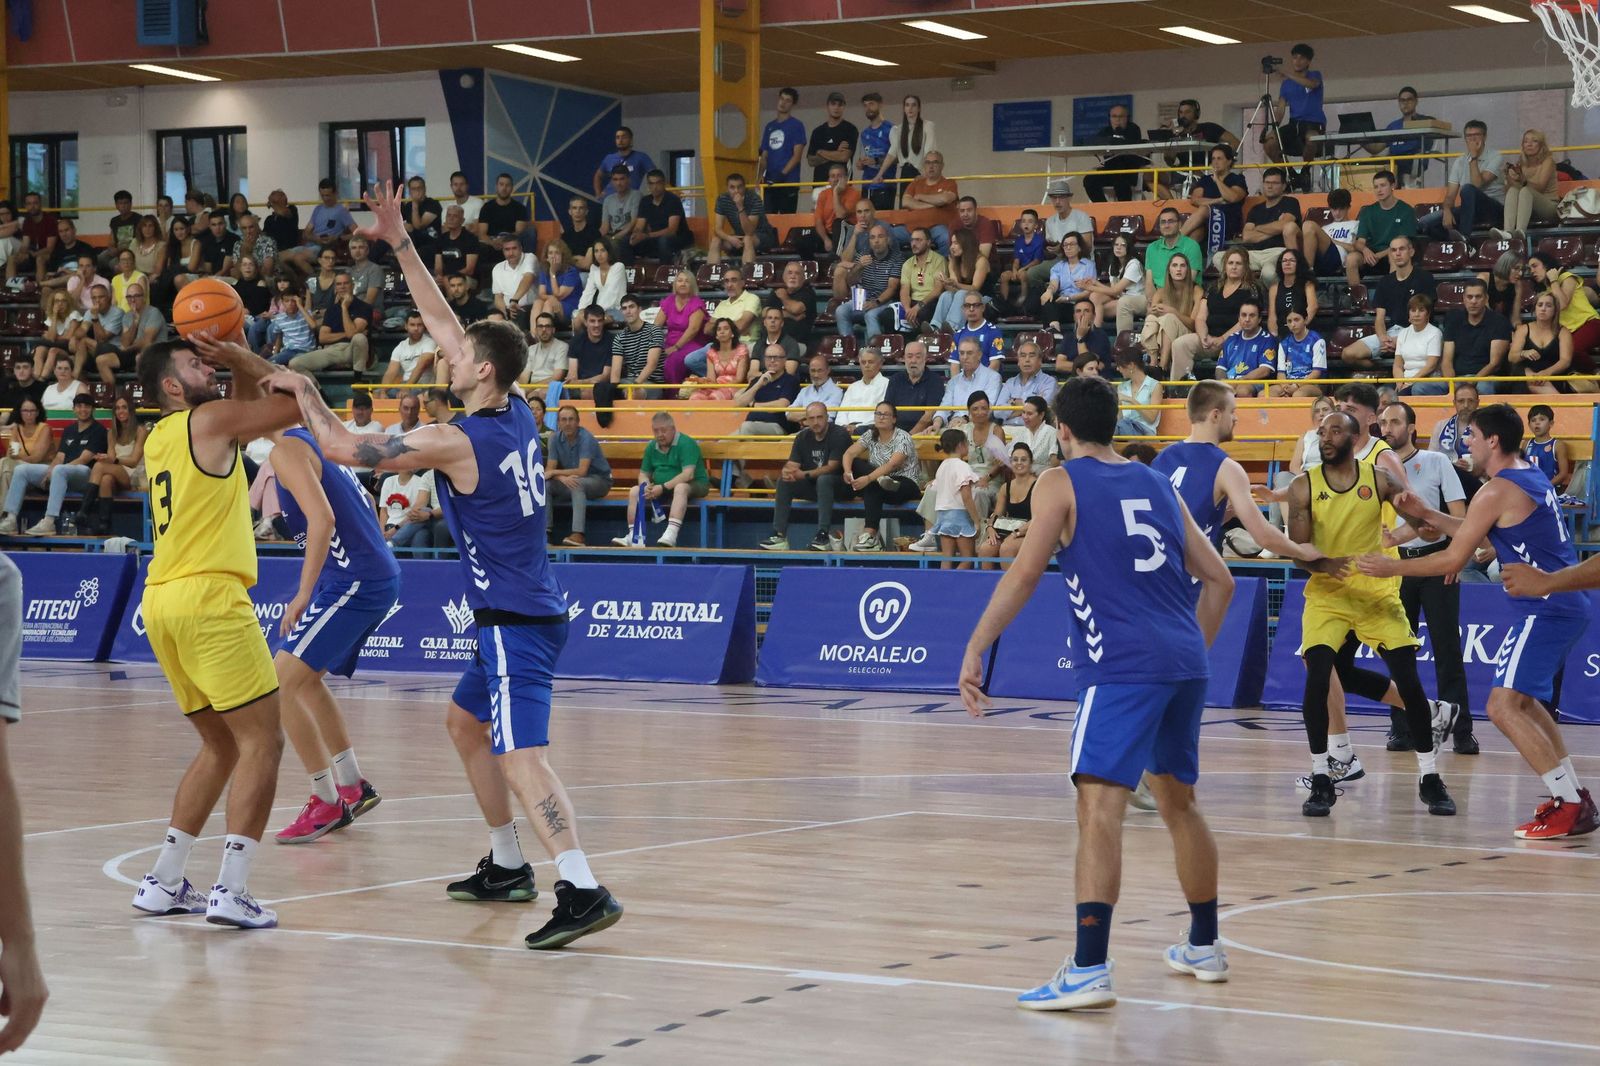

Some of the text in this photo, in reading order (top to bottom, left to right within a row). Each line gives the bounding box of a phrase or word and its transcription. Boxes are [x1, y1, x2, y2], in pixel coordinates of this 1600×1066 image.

[1323, 210, 1331, 219] 7
[1122, 218, 1129, 226] 2
[1441, 243, 1454, 254] 13
[1496, 241, 1510, 251] 15
[1556, 239, 1569, 249] 17
[835, 339, 842, 347] 8
[884, 339, 890, 347] 6
[498, 438, 546, 518] 16
[149, 470, 173, 541] 13
[1545, 488, 1570, 543] 1
[1120, 498, 1167, 573] 5
[26, 599, 81, 620] FITECU
[591, 600, 723, 623] CAJA RURAL
[587, 624, 684, 640] DE ZAMORA
[364, 636, 404, 649] RURAL
[419, 637, 448, 650] CAJA
[358, 649, 389, 659] AMORA
[424, 650, 437, 659] DE
[819, 644, 928, 664] MORALEJO
[848, 666, 892, 675] SELECCIÓN
